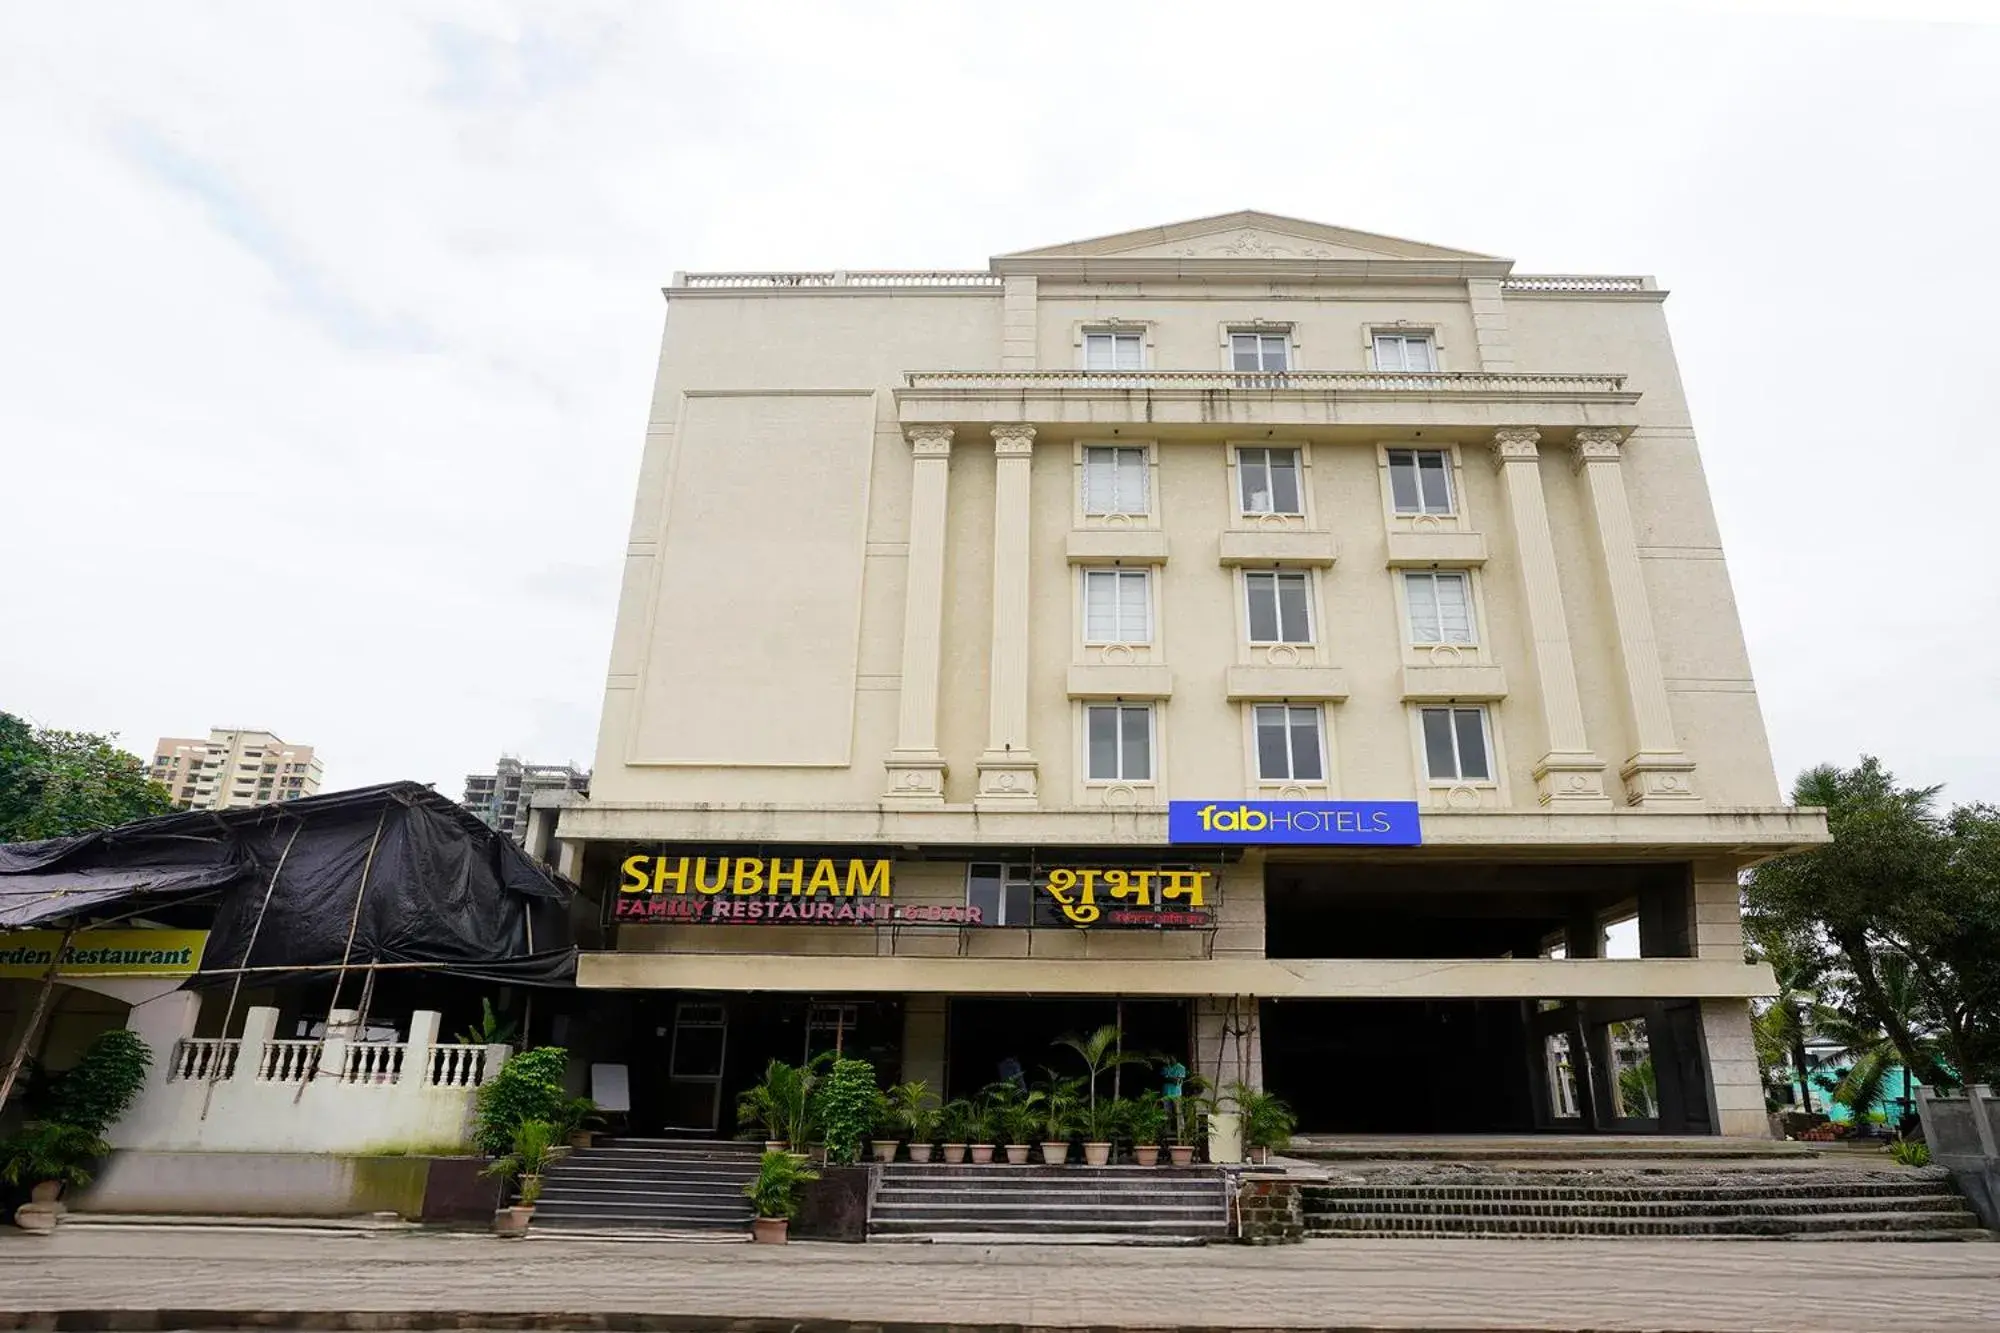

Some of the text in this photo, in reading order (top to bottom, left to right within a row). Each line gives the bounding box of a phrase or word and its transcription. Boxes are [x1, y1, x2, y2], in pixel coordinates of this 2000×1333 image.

[620, 854, 891, 897] SHUBHAM
[616, 898, 983, 922] FAMILY RESTAURANT & BAR
[1046, 868, 1211, 924] शुभम
[60, 945, 193, 965] Restaurant
